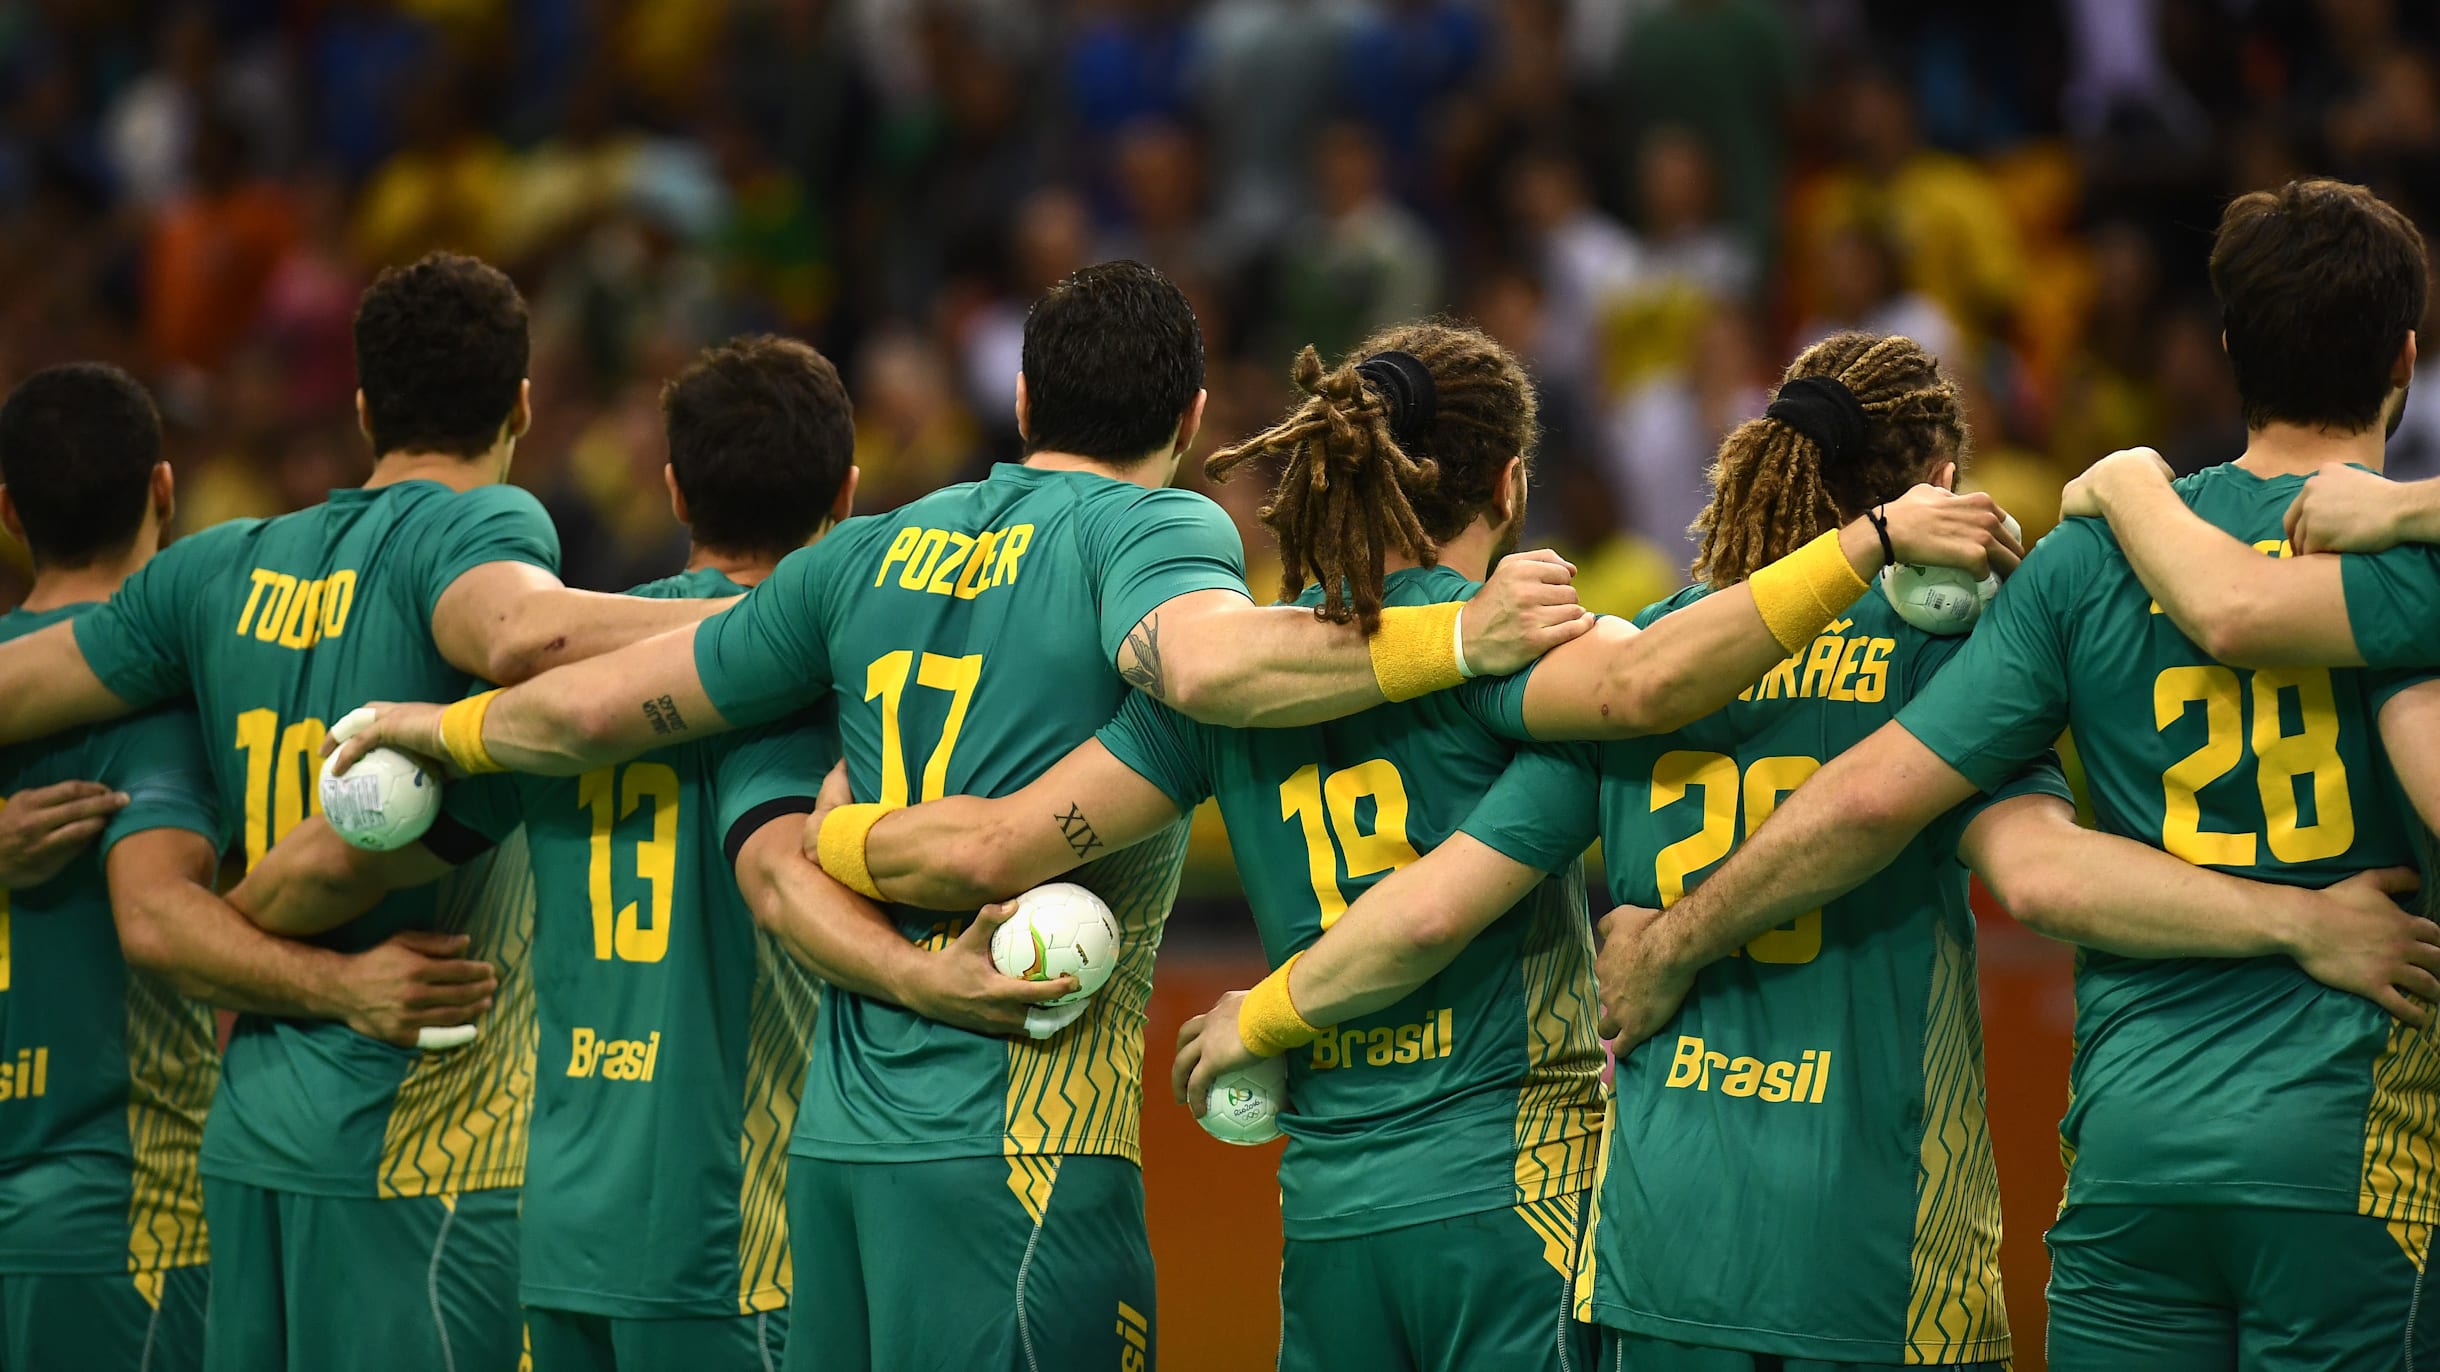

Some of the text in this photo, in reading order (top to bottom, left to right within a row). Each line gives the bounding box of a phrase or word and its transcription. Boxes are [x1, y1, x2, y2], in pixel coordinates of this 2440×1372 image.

[864, 650, 983, 811] 17
[2153, 664, 2355, 866] 28
[577, 761, 680, 963] 13
[1053, 801, 1104, 859] XIX
[1279, 758, 1423, 932] 19
[566, 1027, 661, 1082] Brasil
[1310, 1007, 1453, 1070] Brasil
[1665, 1035, 1832, 1104] Brasil
